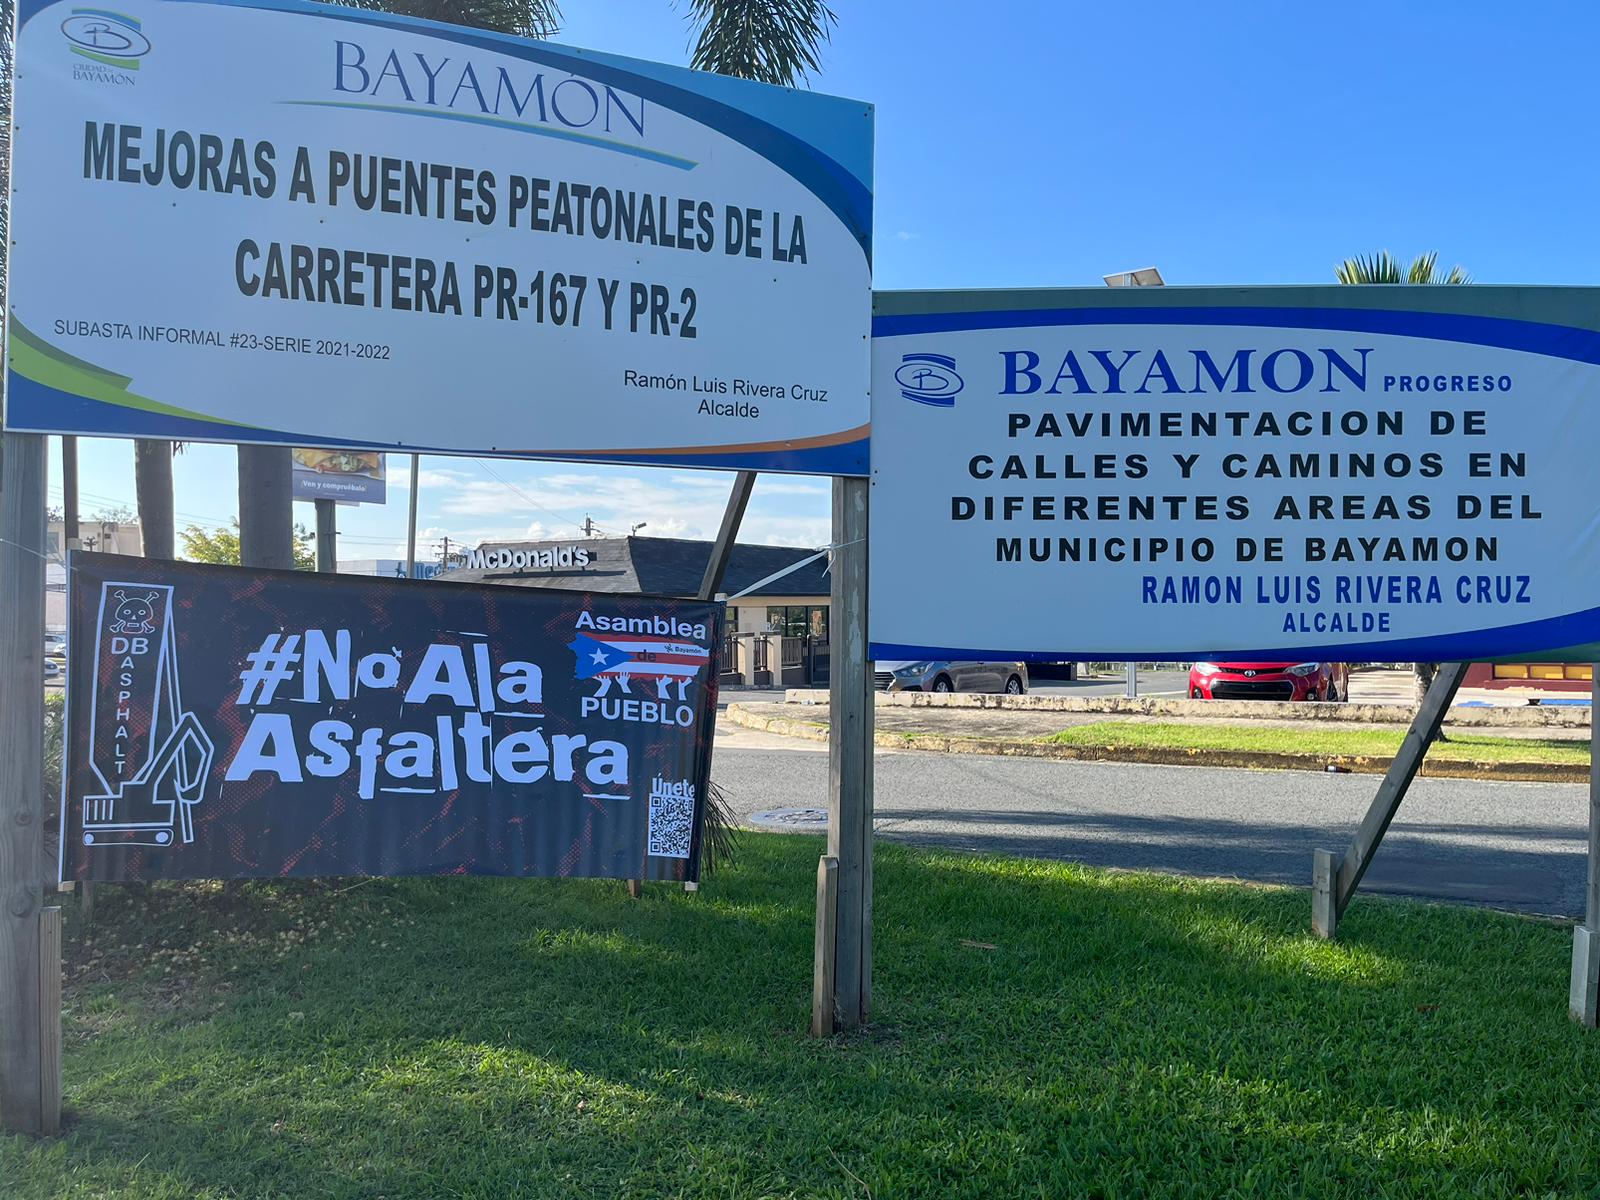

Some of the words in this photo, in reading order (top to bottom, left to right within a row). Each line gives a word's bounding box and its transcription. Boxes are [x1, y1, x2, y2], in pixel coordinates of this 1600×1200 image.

[333, 39, 645, 137] BAYAMÓN
[83, 120, 277, 199] MEJORAS
[288, 146, 316, 204] A
[328, 150, 496, 226] PUENTES
[508, 174, 715, 253] PEATONALES
[724, 205, 763, 259] DE
[772, 211, 808, 265] LA
[235, 238, 463, 317] CARRETERA
[474, 264, 588, 327] PR-167
[597, 277, 620, 330] Y
[629, 282, 698, 339] PR-2
[54, 319, 133, 340] SUBASTA
[138, 325, 225, 347] INFORMAL
[230, 332, 312, 354] #23-SERIE
[316, 340, 390, 360] 2021-2022
[624, 370, 687, 391] Ramón
[693, 376, 727, 394] Luis
[733, 379, 785, 399] Rivera
[791, 384, 828, 402] Cruz
[998, 348, 1375, 395] BAYAMON
[1384, 375, 1512, 392] PROGRESO
[698, 399, 760, 419] Alcalde
[1008, 411, 1403, 437] PAVIMENTACION
[1430, 410, 1487, 436] DE
[968, 454, 1149, 479] CALLES
[1173, 454, 1200, 478] Y
[1222, 452, 1444, 478] CAMINOS
[1469, 452, 1526, 477] EN
[951, 495, 1250, 521] DIFERENTES
[1273, 494, 1432, 520] AREAS
[1457, 494, 1542, 519] DEL
[467, 546, 590, 569] McDonald's
[996, 537, 1215, 562] MUNICIPIO
[1236, 537, 1283, 562] DE
[1305, 536, 1498, 562] BAYAMON
[1142, 575, 1242, 604] RAMON
[1257, 575, 1321, 603] LUIS
[1336, 575, 1442, 603] RIVERA
[1455, 575, 1531, 602] CRUZ
[575, 610, 706, 640] Asamblea
[1283, 612, 1391, 633] ALCALDE
[111, 637, 149, 655] DB
[637, 649, 657, 662] de
[114, 656, 134, 774] ASPHALT
[581, 696, 694, 727] PUEBLO
[225, 712, 629, 800] Asfaltera
[652, 772, 695, 797] Únete
